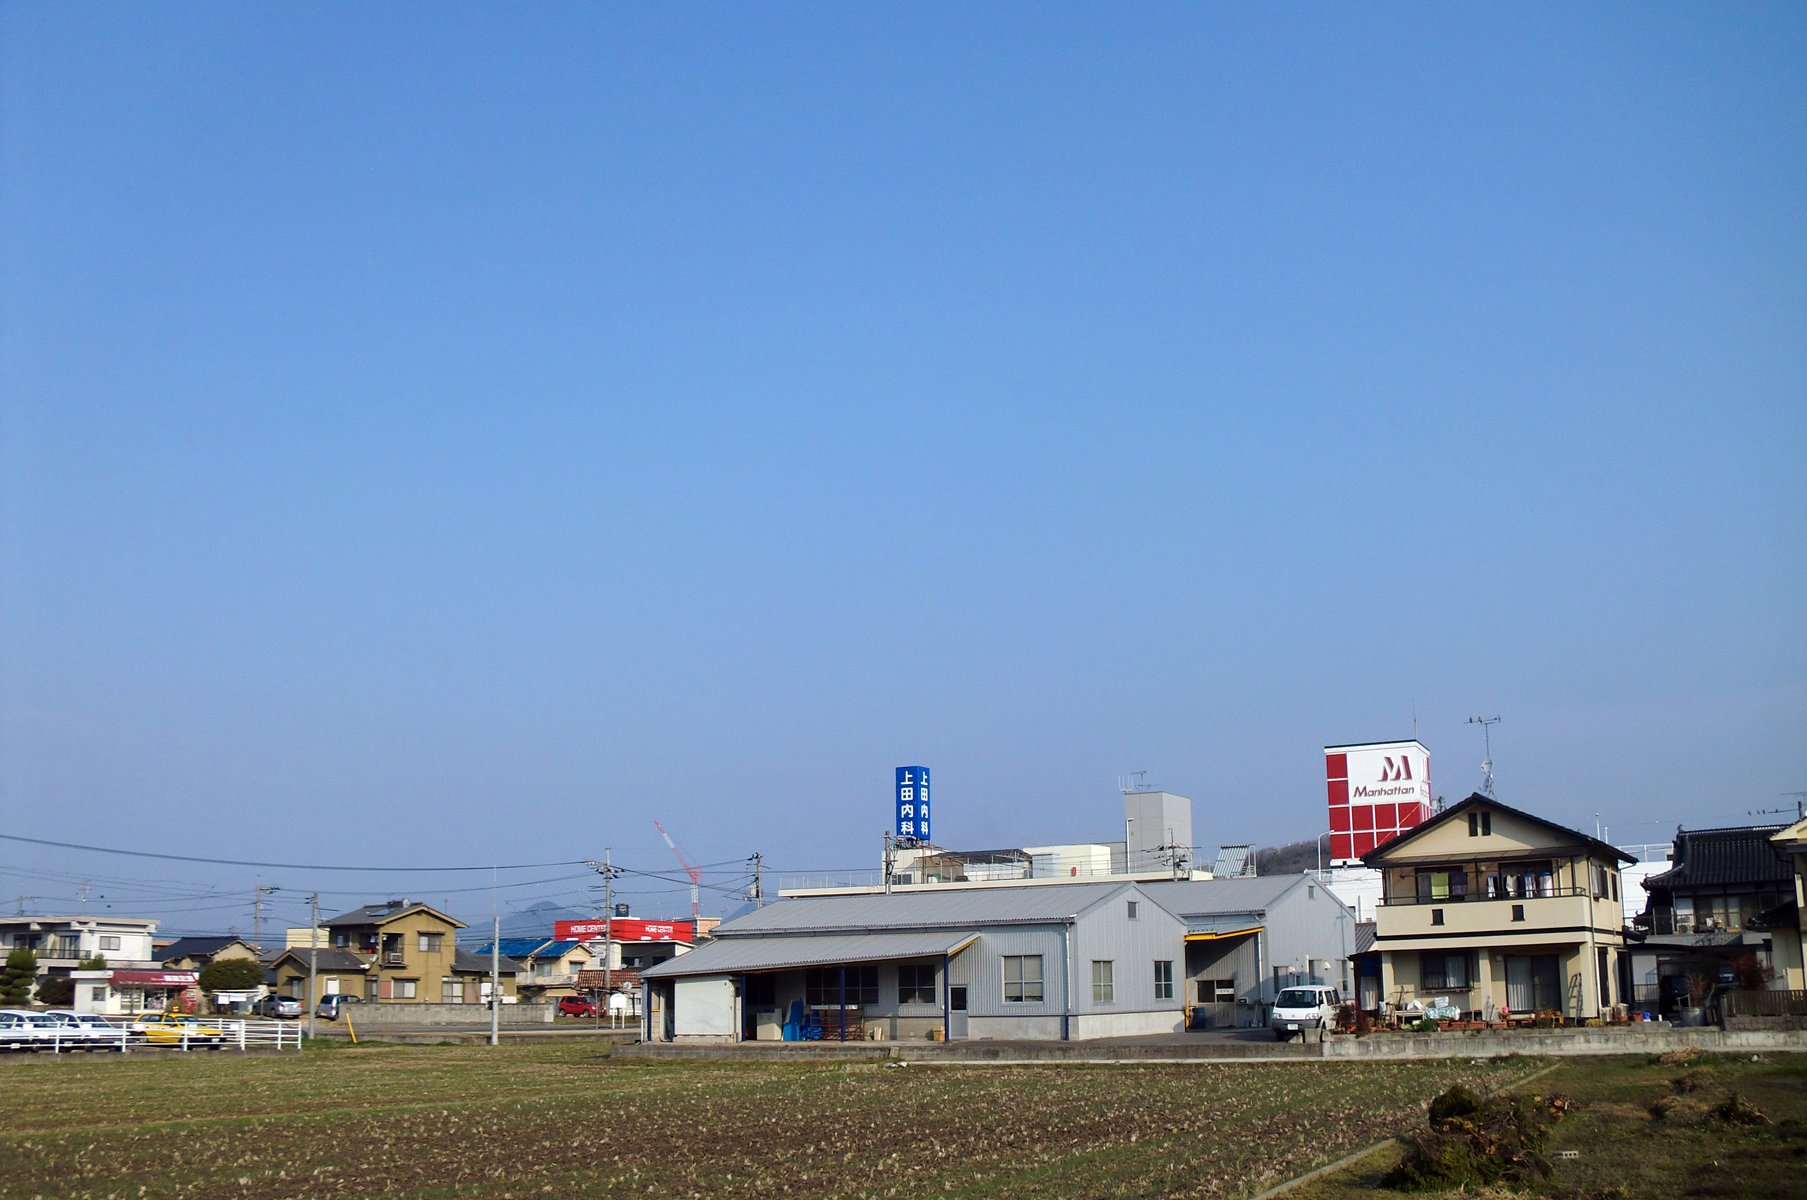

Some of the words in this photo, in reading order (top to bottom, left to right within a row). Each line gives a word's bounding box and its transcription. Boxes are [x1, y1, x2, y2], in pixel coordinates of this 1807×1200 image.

[1353, 785, 1415, 798] Manhattan
[900, 770, 914, 835] 上田内科
[570, 925, 586, 933] HOME
[587, 924, 607, 932] CENTE
